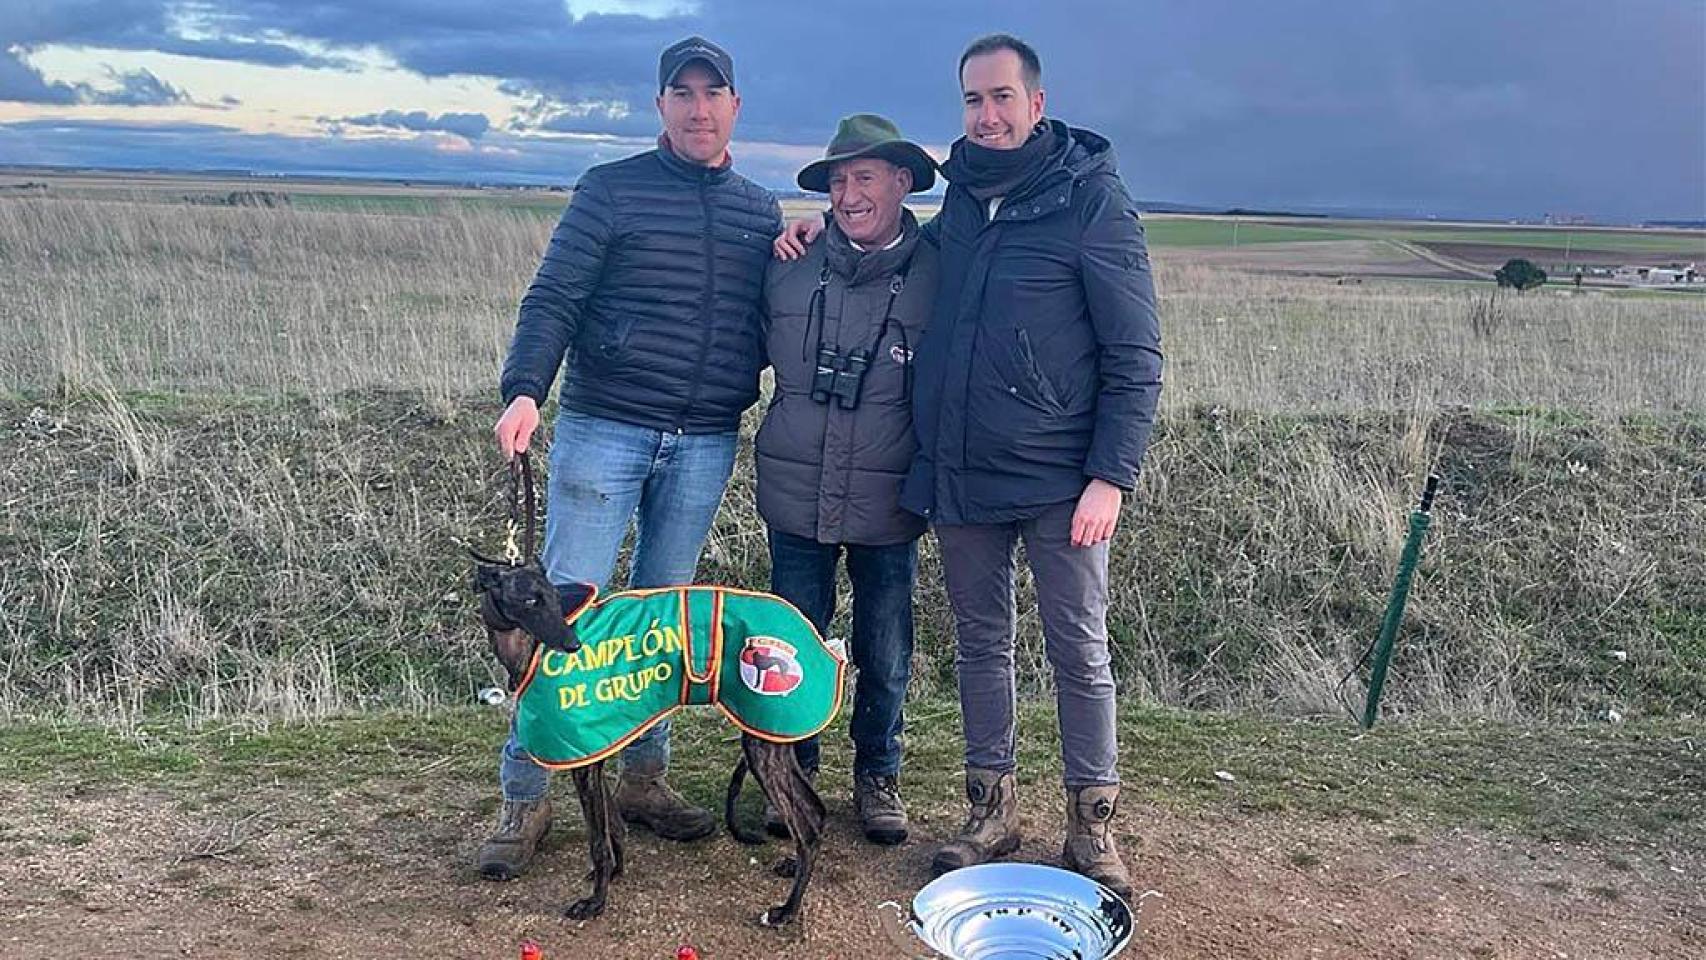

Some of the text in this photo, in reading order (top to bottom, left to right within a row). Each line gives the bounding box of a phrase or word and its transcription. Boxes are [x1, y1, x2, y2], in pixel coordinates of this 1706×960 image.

[542, 618, 684, 676] CAMPEÓN
[559, 662, 672, 709] DE GRUPO
